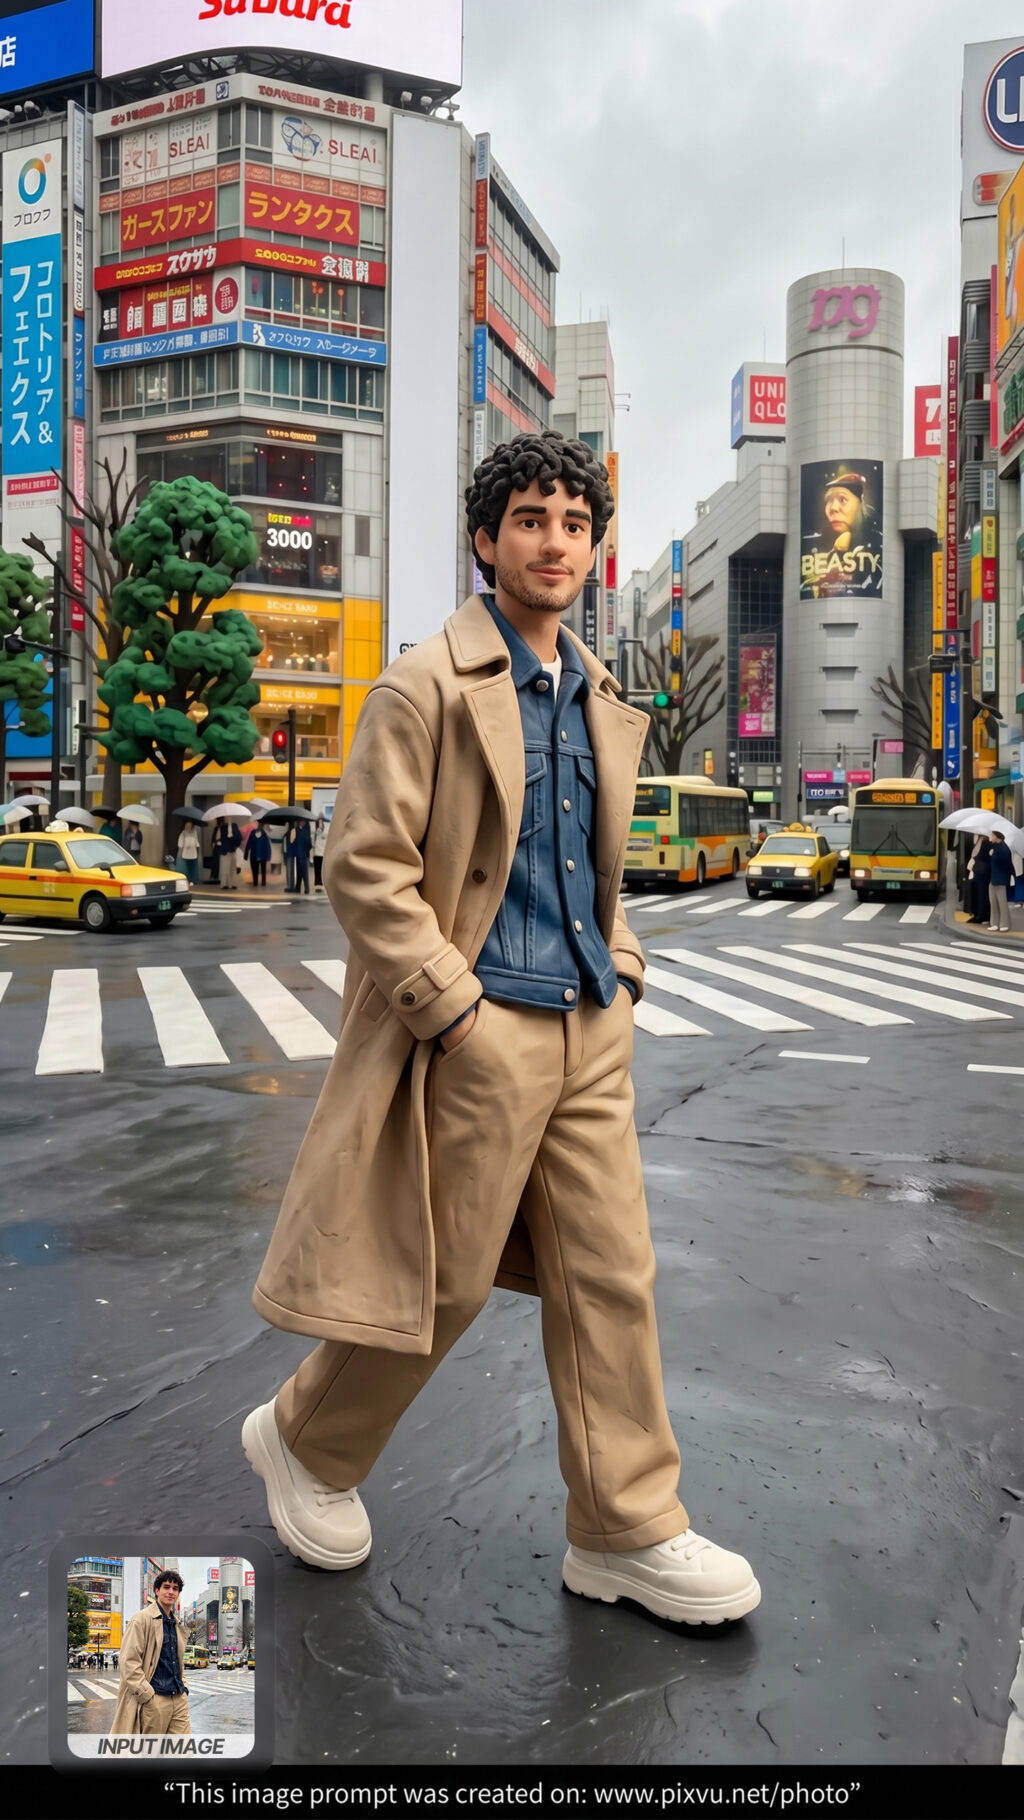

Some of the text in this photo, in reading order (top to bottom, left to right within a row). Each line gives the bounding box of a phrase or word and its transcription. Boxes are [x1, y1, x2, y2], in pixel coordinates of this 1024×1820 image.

[328, 139, 377, 164] SLEAI
[122, 200, 213, 241] ガースファン
[248, 191, 354, 236] ランタクス
[754, 381, 784, 399] UNI
[266, 527, 313, 551] 3000
[801, 551, 880, 576] BEASTY
